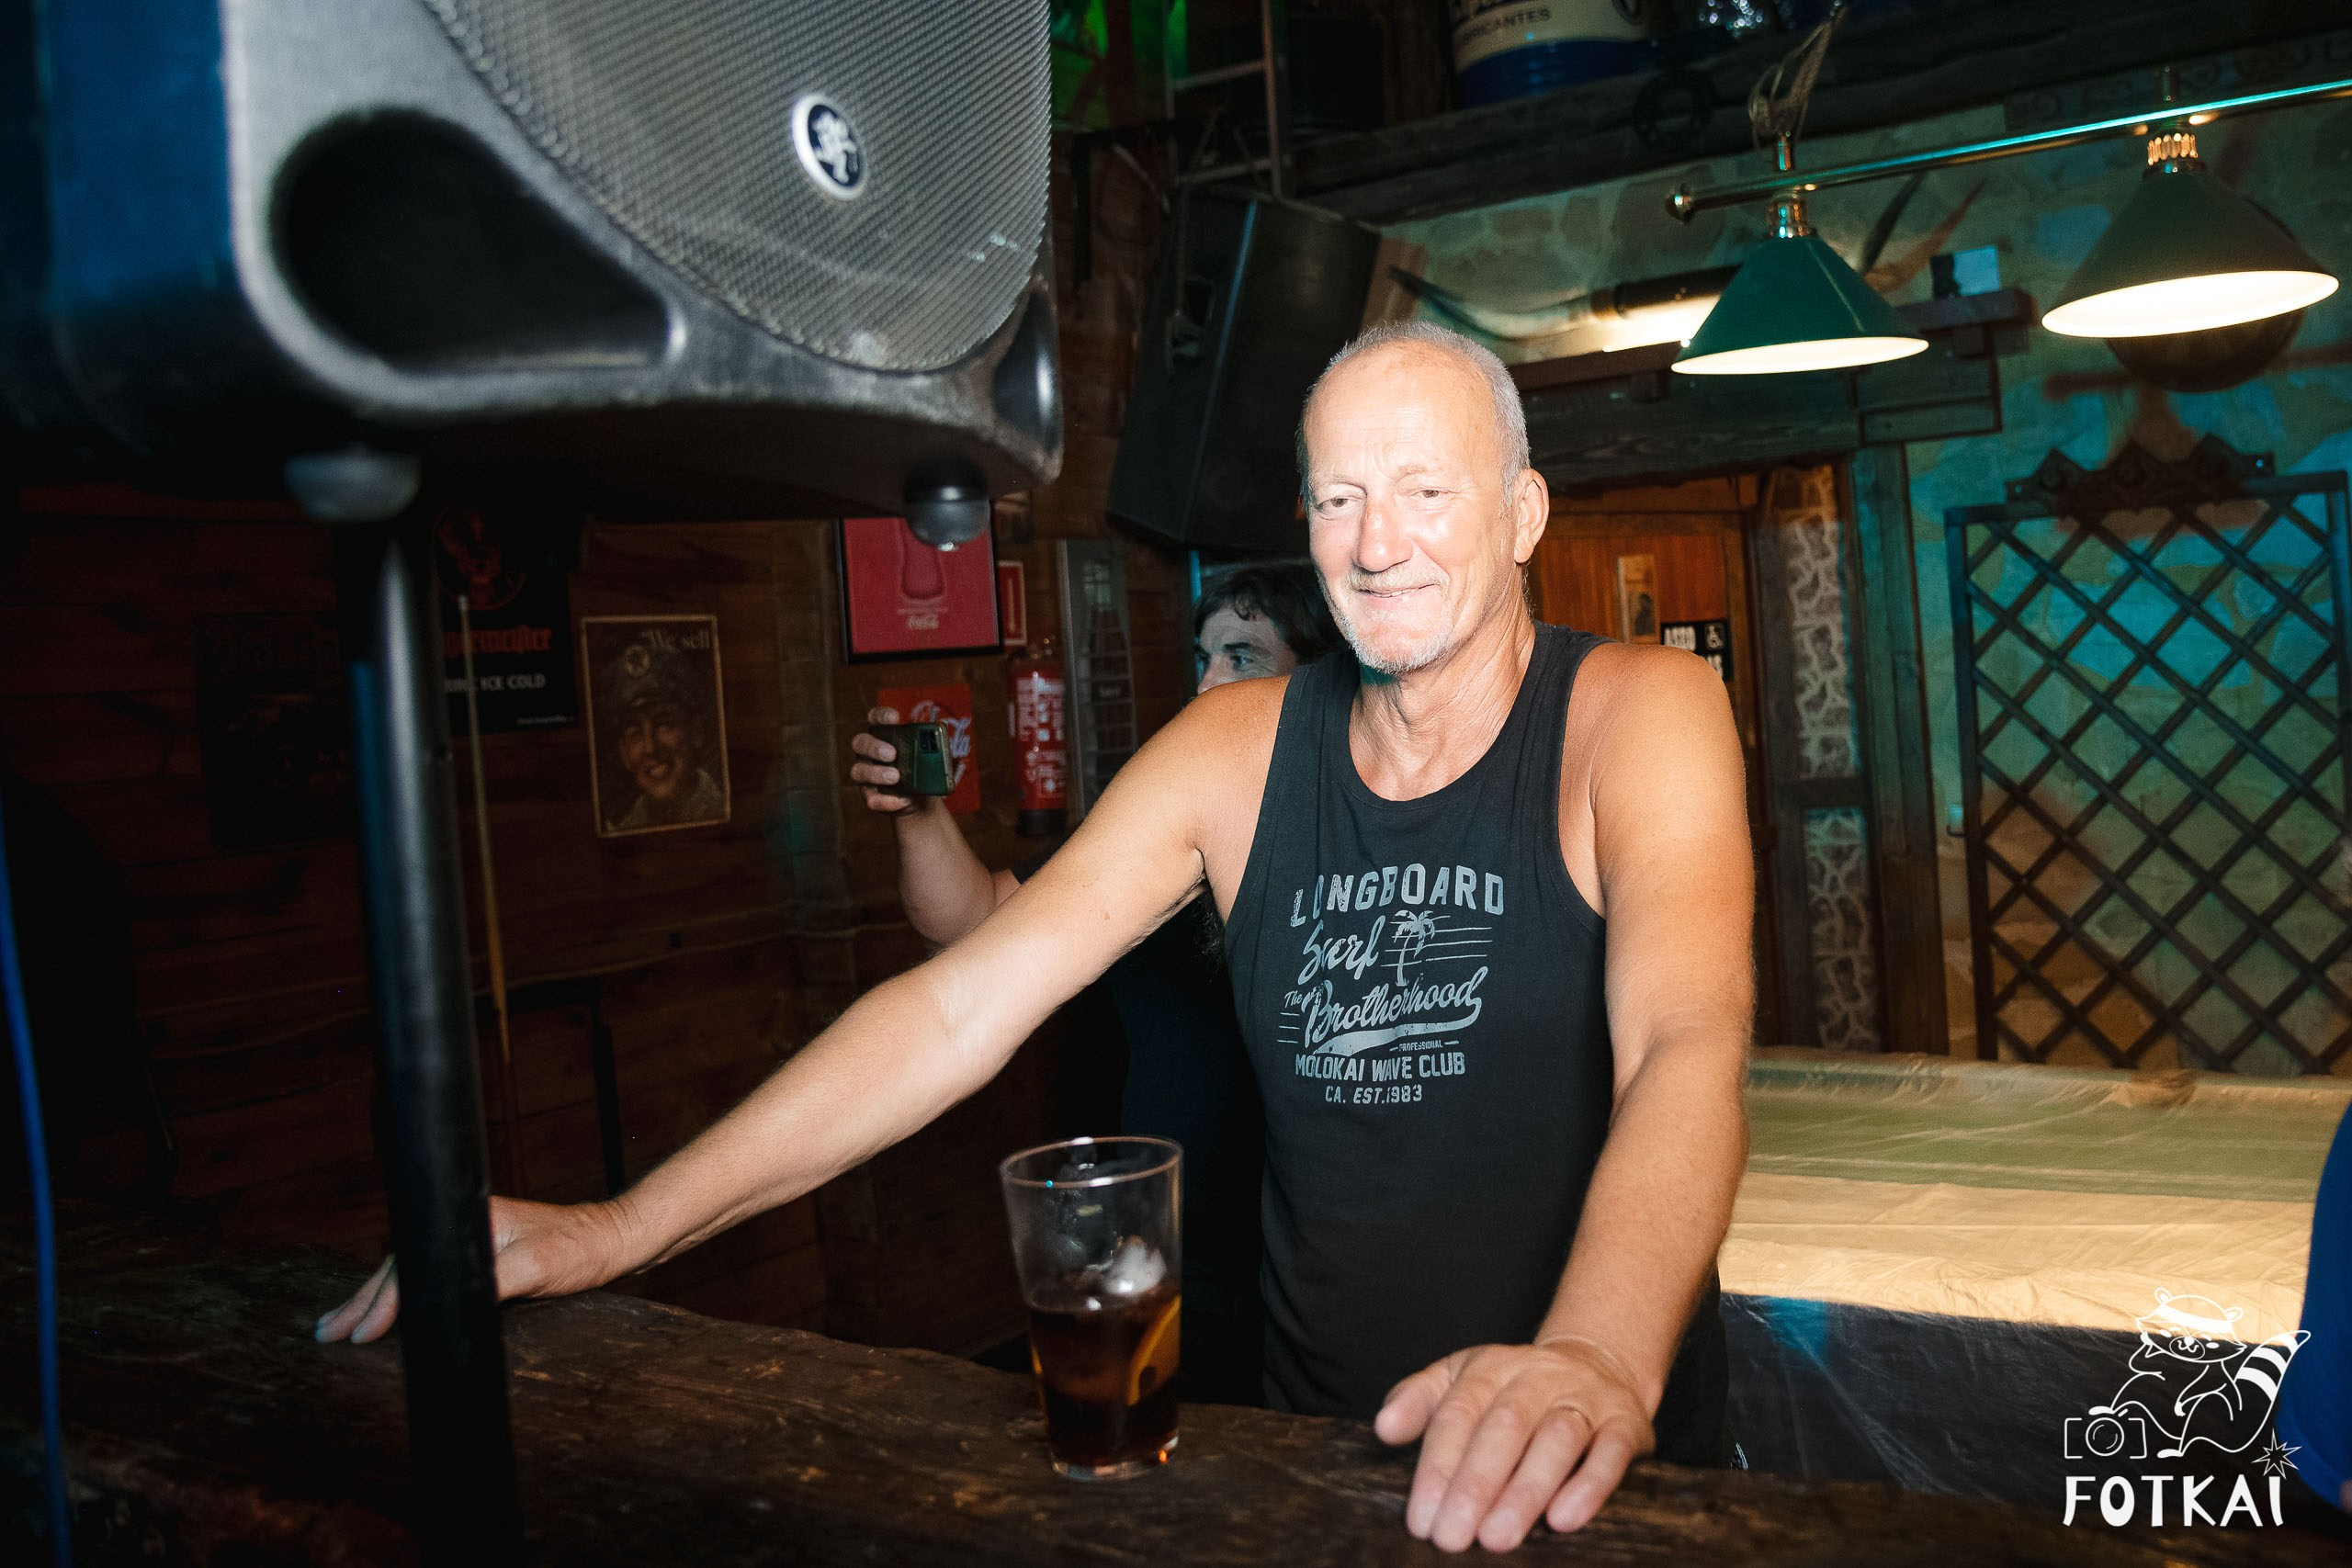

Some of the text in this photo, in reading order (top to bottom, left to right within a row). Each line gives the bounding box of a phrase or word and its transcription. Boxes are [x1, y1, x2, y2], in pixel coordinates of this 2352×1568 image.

[507, 672, 547, 690] COLD
[1290, 863, 1504, 928] LONGBOARD
[1284, 965, 1489, 1049] The Brotherhood
[1295, 1051, 1466, 1082] MOLOKAI WAVE CLUB
[1325, 1085, 1346, 1104] CA.
